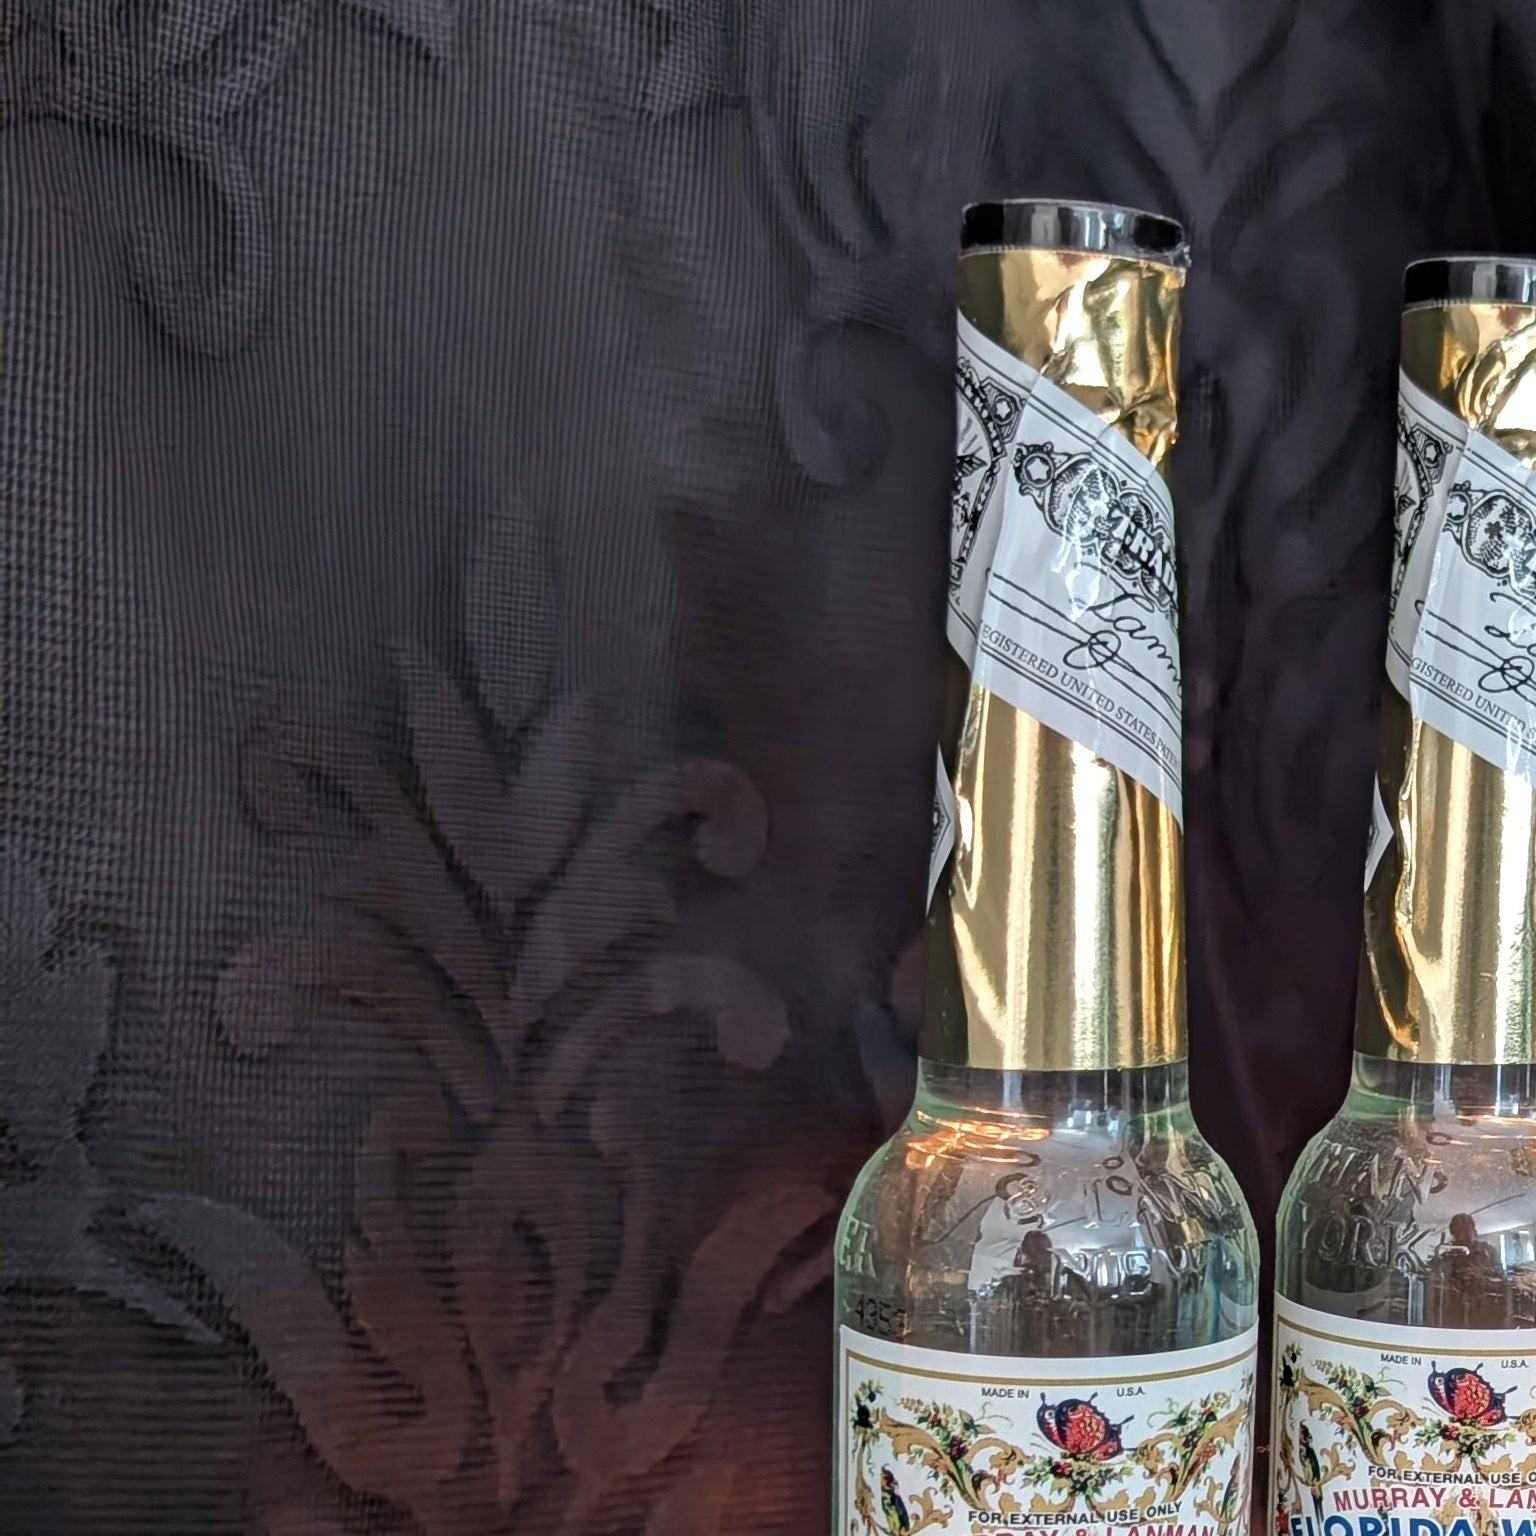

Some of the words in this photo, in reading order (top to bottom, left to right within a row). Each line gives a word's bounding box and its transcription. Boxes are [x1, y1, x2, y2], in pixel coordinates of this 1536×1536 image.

[1109, 507, 1178, 608] TRAD
[982, 624, 1059, 679] EGISTERED
[1060, 671, 1115, 713] UNITED
[1115, 708, 1157, 745] STATES
[1410, 657, 1473, 701] GISTERED
[1380, 1353, 1408, 1365] MADE
[1411, 1357, 1422, 1366] IN
[1501, 1359, 1529, 1369] U.S.A.
[981, 1387, 1015, 1398] MADE
[1017, 1388, 1029, 1399] IN
[1368, 1465, 1397, 1479] FOR
[1403, 1470, 1483, 1485] EXTERNAL
[1490, 1472, 1520, 1484] USE
[1333, 1487, 1446, 1512] MURRAY
[1459, 1488, 1480, 1508] &
[968, 1510, 1001, 1525] FOR
[1009, 1511, 1098, 1526] EXTERNAL
[1107, 1508, 1138, 1523] USE
[1146, 1502, 1182, 1518] ONLY
